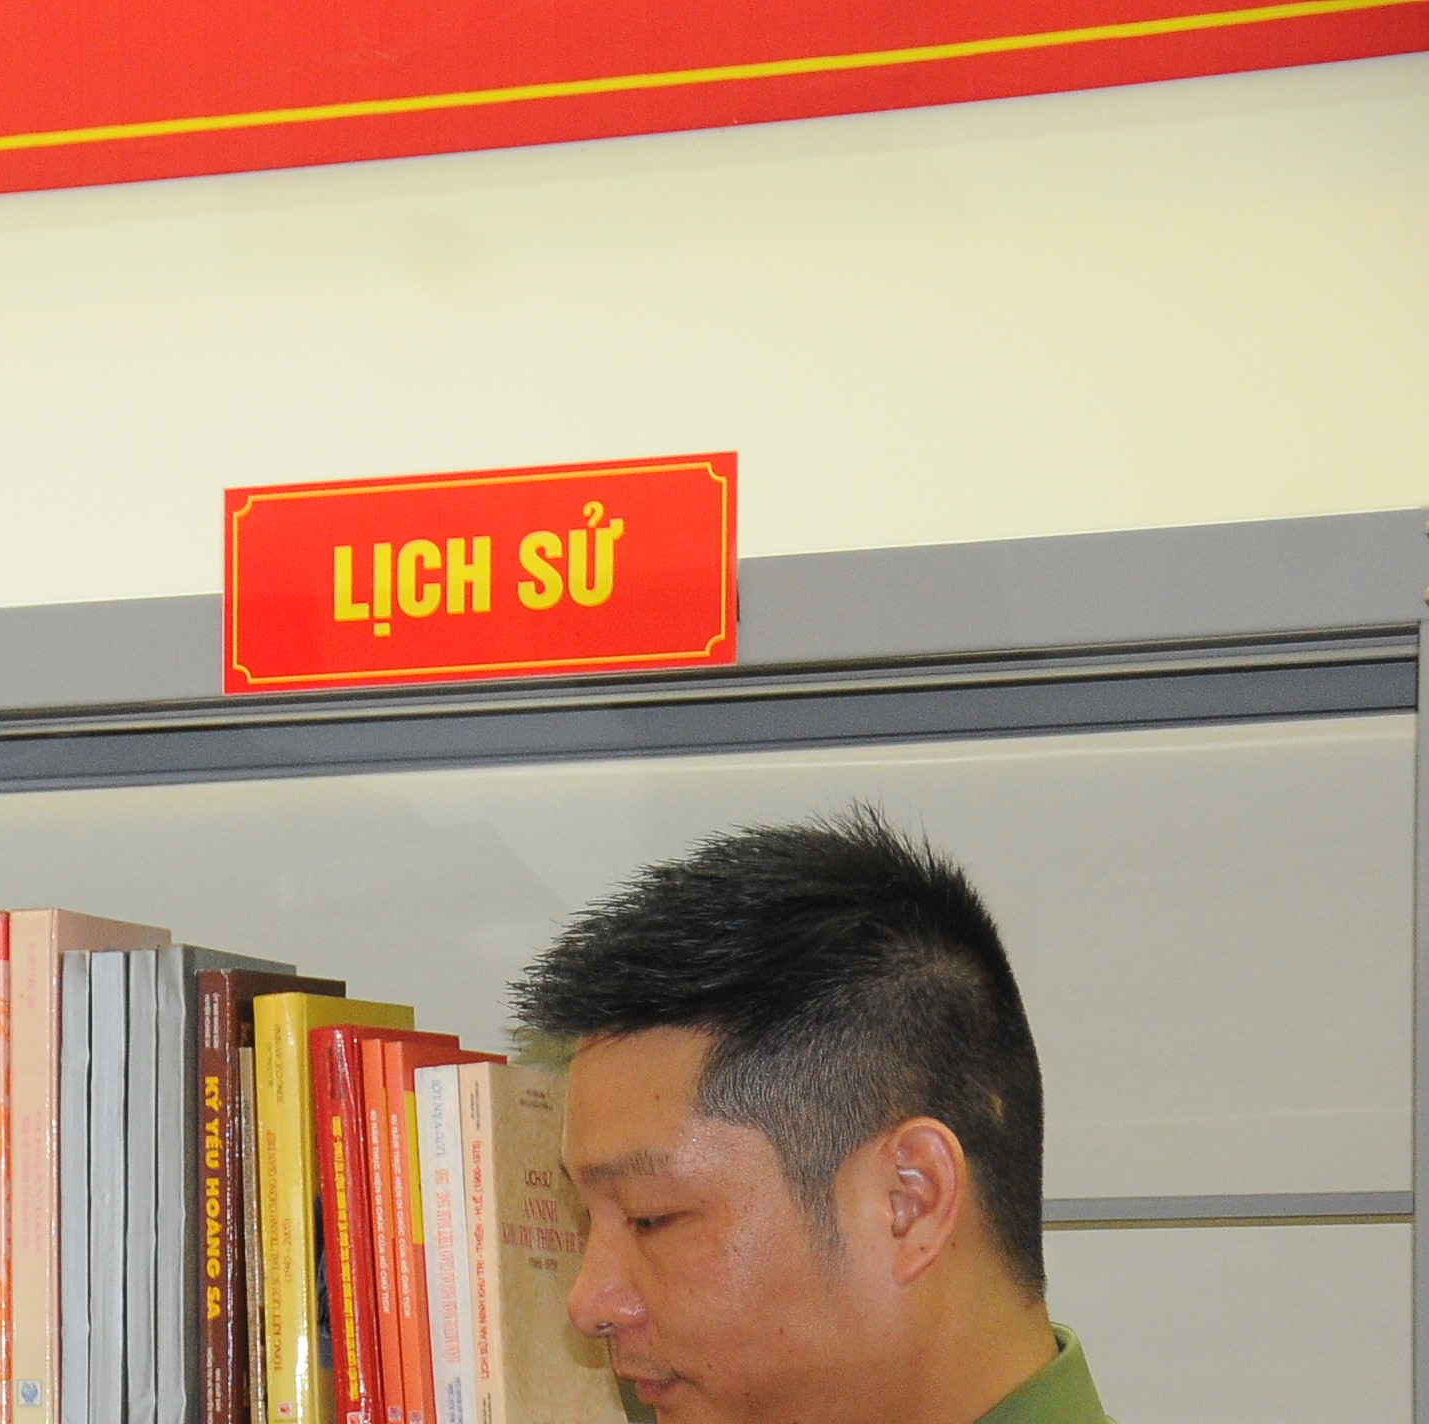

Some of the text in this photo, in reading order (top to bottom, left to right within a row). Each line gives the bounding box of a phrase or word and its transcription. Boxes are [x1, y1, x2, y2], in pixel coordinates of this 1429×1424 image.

[334, 501, 624, 637] LỊCH SỬ
[204, 1075, 223, 1321] KỶ YẾU HOÀNG SA
